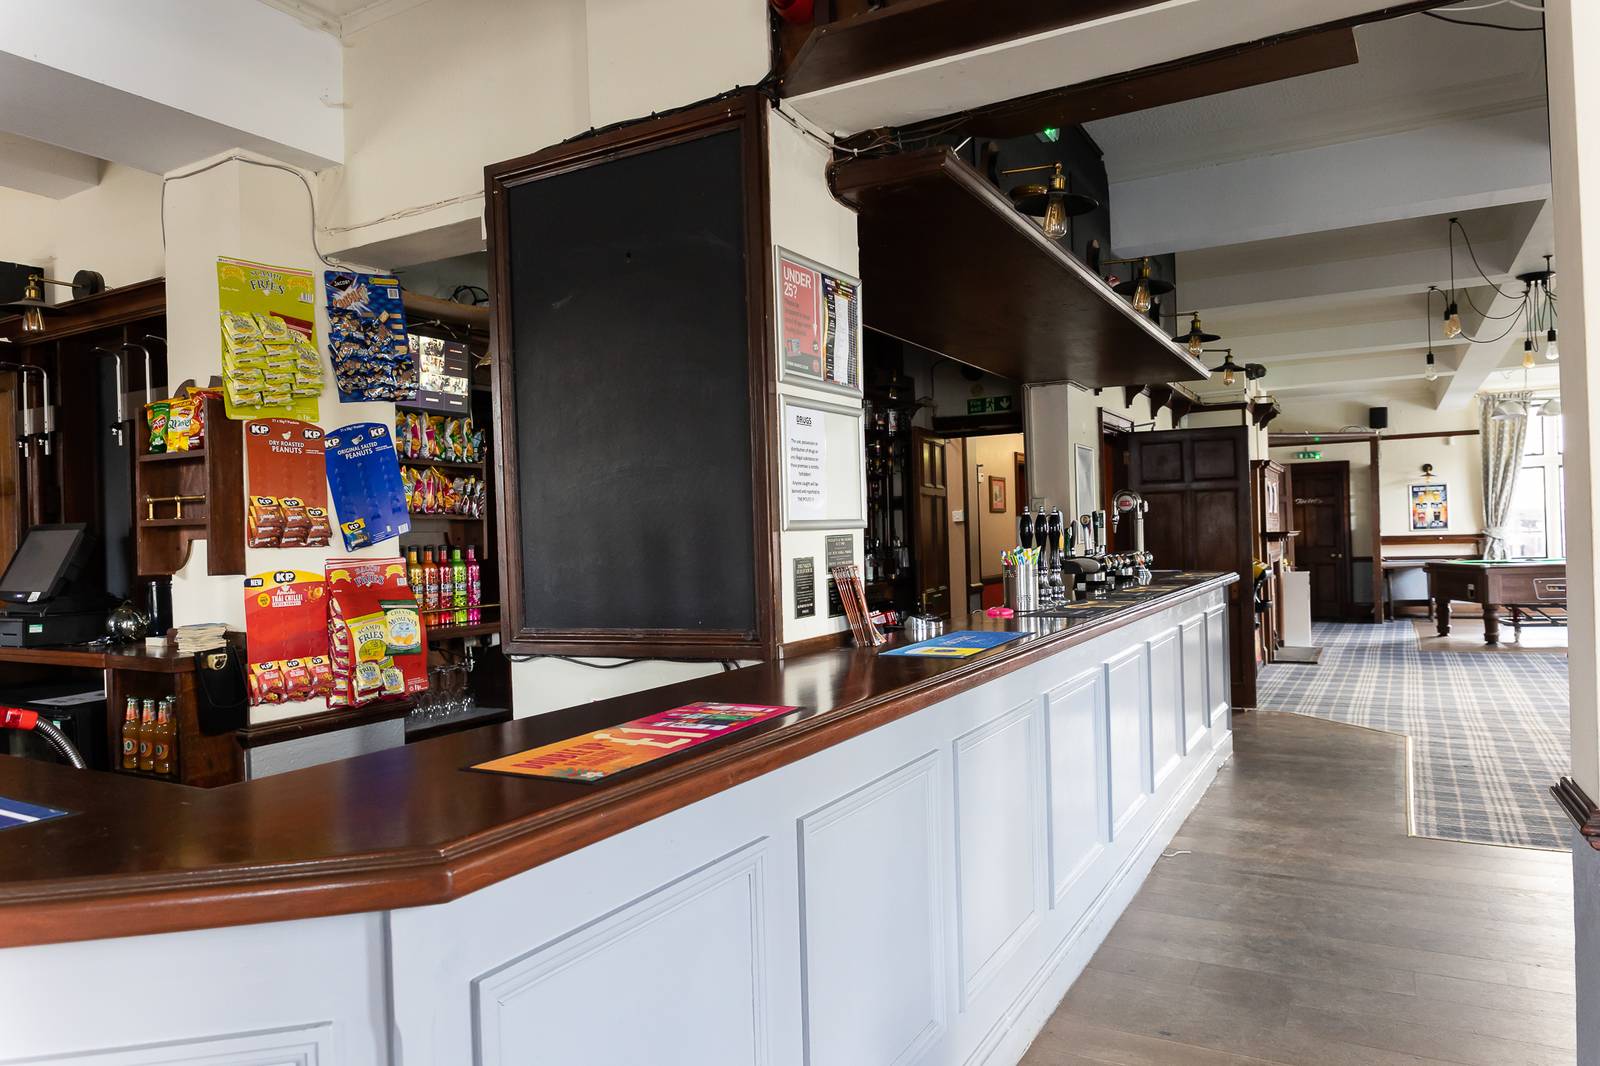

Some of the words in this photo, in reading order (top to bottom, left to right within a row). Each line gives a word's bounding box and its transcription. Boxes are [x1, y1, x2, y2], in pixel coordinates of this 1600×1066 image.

[783, 266, 811, 288] UNDER
[250, 278, 285, 294] FRIES
[784, 282, 798, 298] 25?
[796, 415, 812, 424] DRUGS
[251, 425, 268, 434] KP
[370, 428, 385, 437] KP
[304, 430, 320, 439] KP
[325, 438, 340, 448] KP
[272, 446, 302, 454] PEANUTS
[337, 446, 360, 455] ORIGINAL
[345, 448, 373, 460] PEANUTS
[276, 573, 294, 581] KP
[358, 625, 380, 634] SCAMPI
[358, 631, 384, 644] FRIES
[359, 666, 376, 674] FRIES
[593, 727, 710, 750] £1
